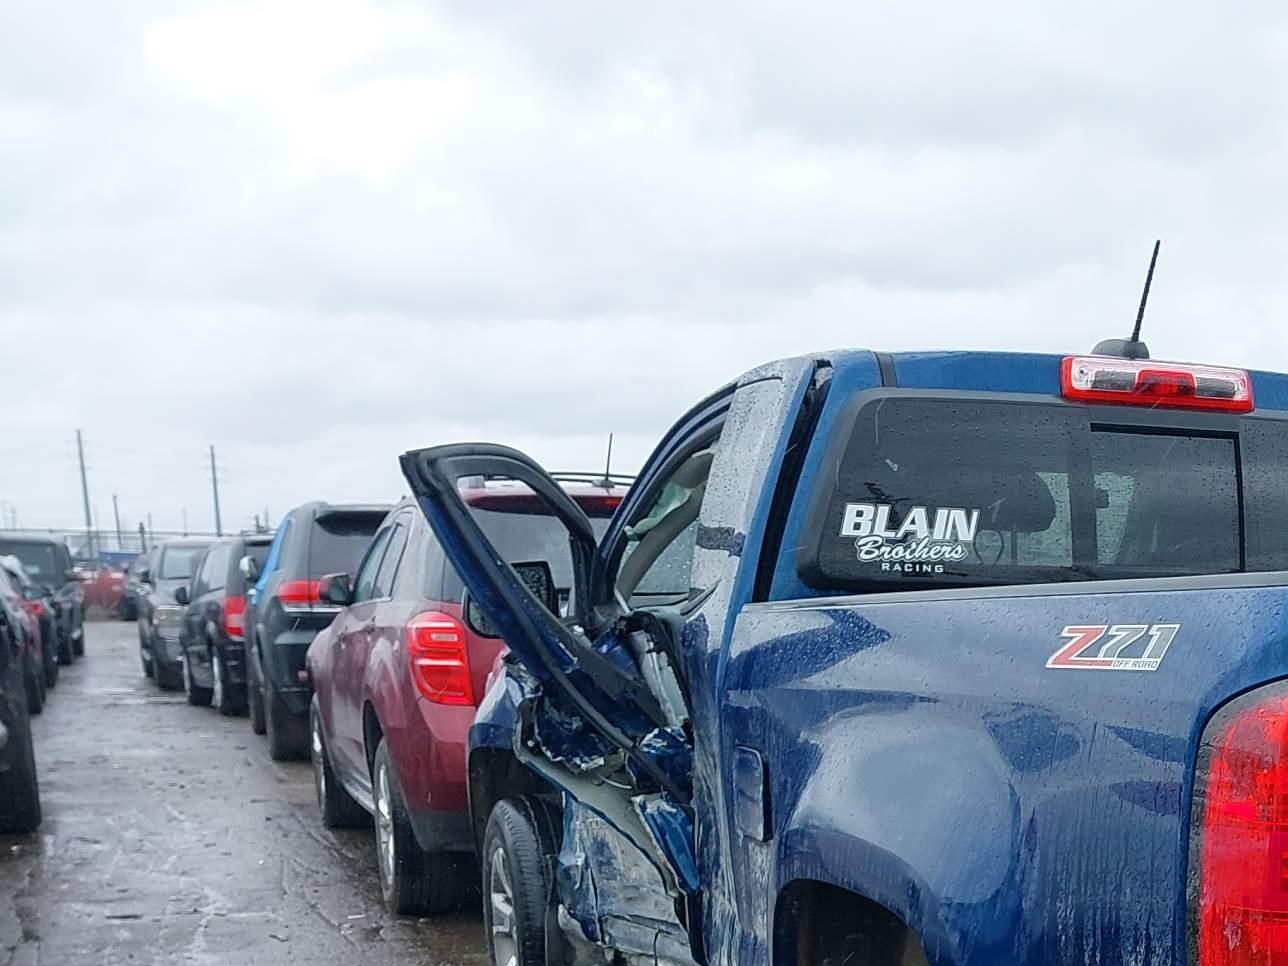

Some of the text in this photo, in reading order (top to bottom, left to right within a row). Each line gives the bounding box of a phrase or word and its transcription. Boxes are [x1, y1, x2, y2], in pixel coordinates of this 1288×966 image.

[840, 503, 980, 541] BLAIN
[856, 536, 967, 562] Brothers
[881, 562, 944, 573] RACING
[1046, 624, 1181, 669] Z71
[1112, 659, 1159, 669] OFF ROAD
